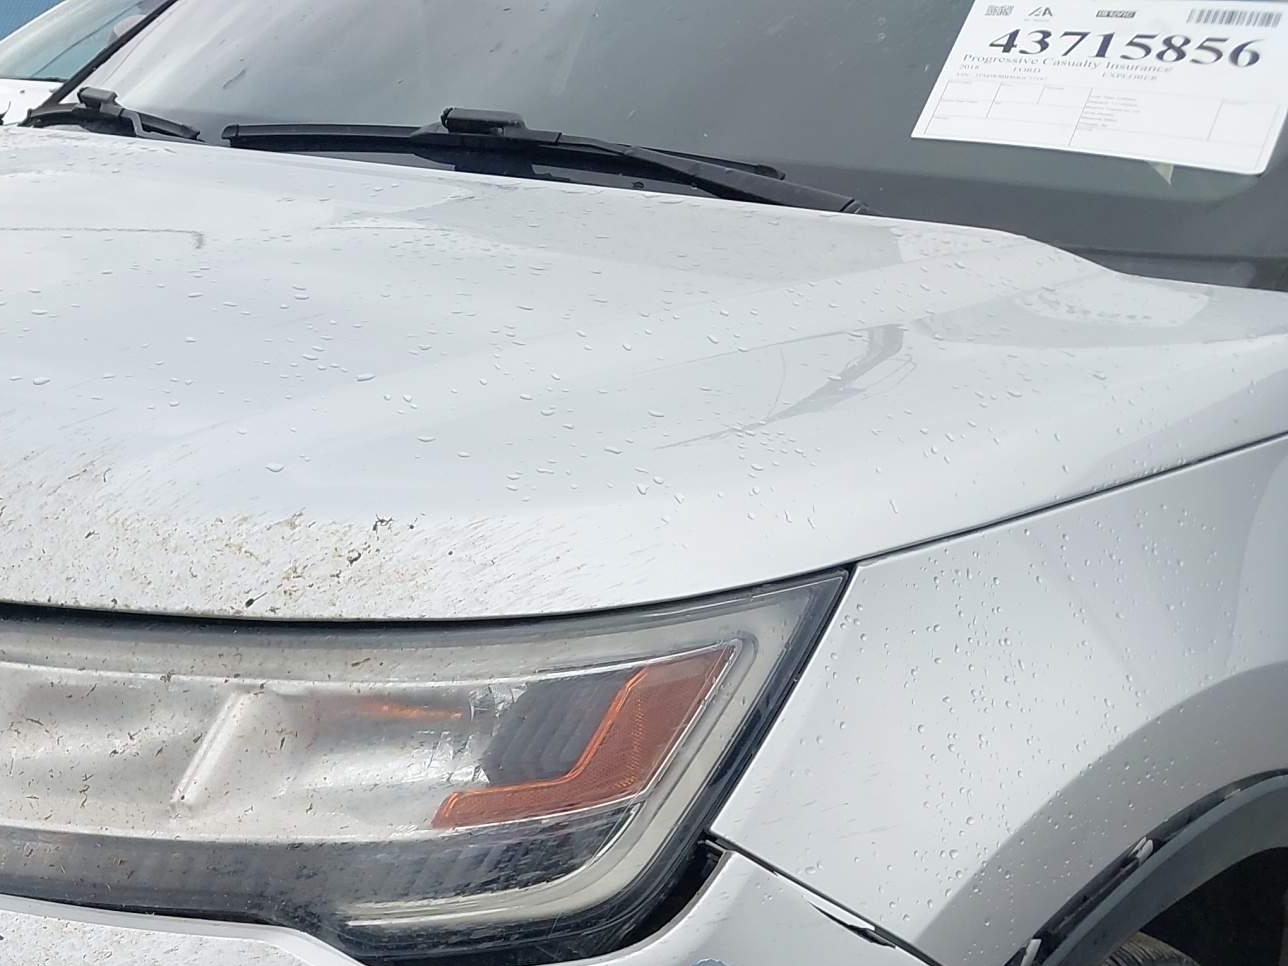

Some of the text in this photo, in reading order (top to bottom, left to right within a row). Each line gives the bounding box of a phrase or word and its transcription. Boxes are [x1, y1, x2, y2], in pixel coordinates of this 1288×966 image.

[962, 53, 1174, 73] Progressive Casualty Insurance
[989, 28, 1265, 68] 43715856
